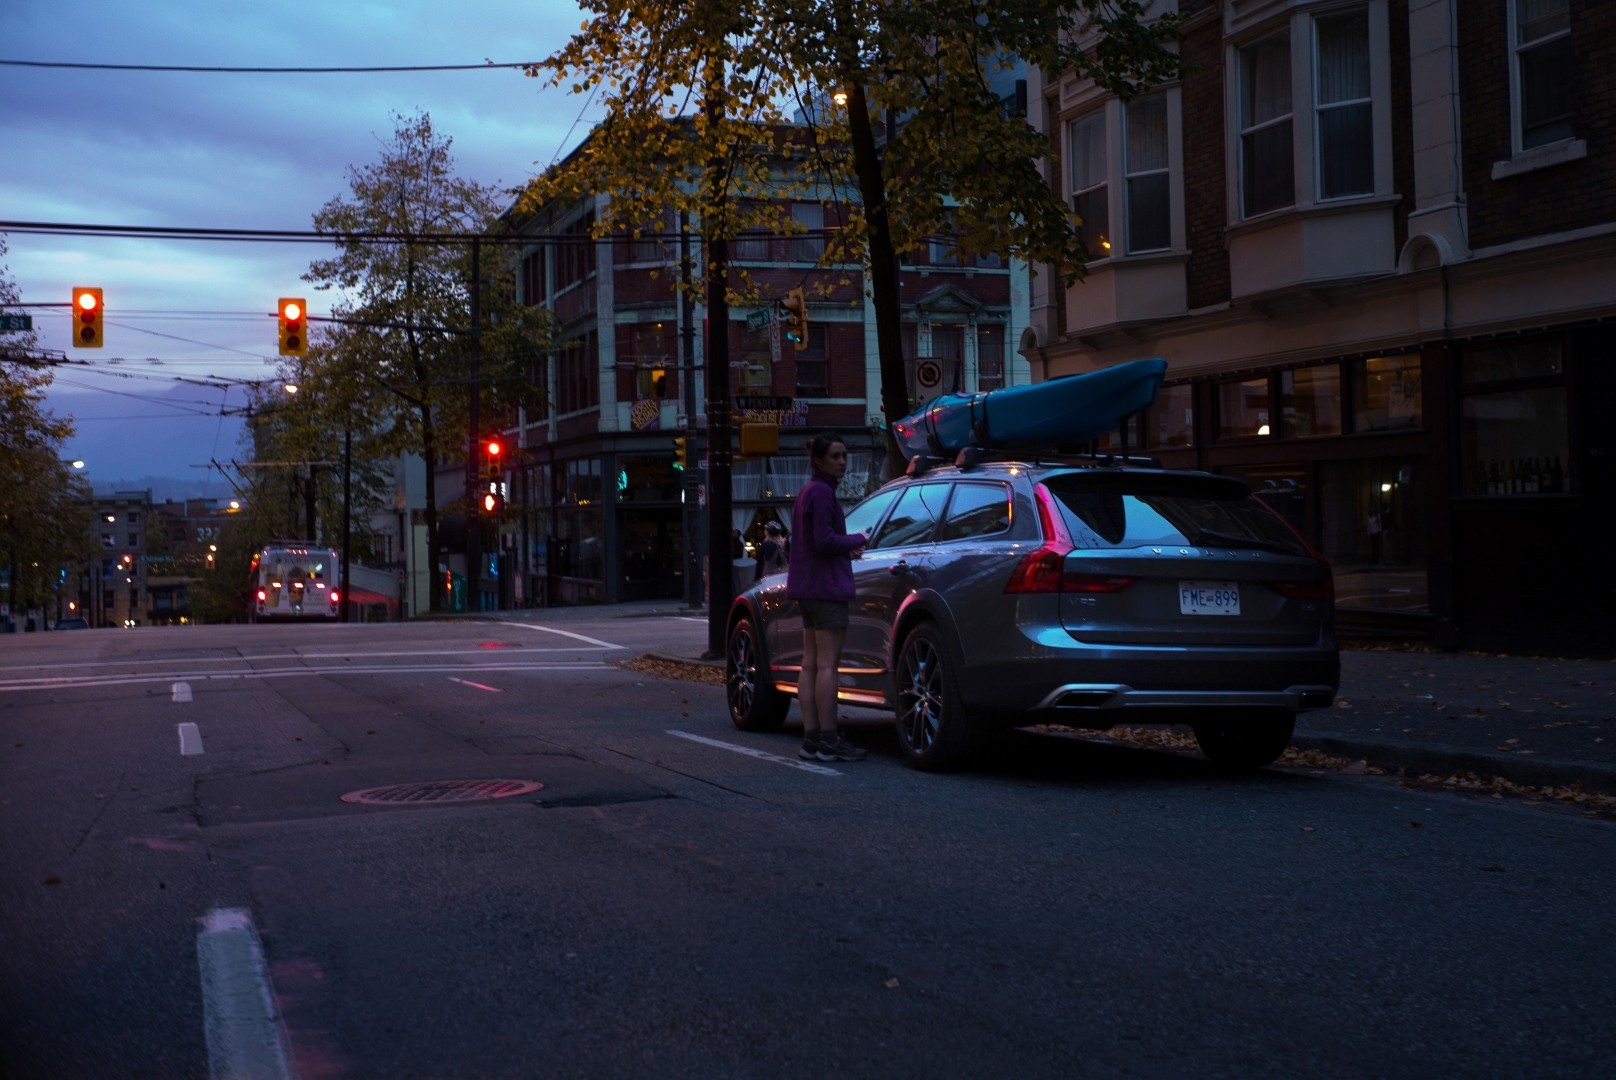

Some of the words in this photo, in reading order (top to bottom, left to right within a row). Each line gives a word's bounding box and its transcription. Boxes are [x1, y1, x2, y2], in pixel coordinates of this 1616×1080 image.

[10, 317, 25, 330] St
[739, 398, 747, 408] W
[750, 398, 776, 408] PENDER
